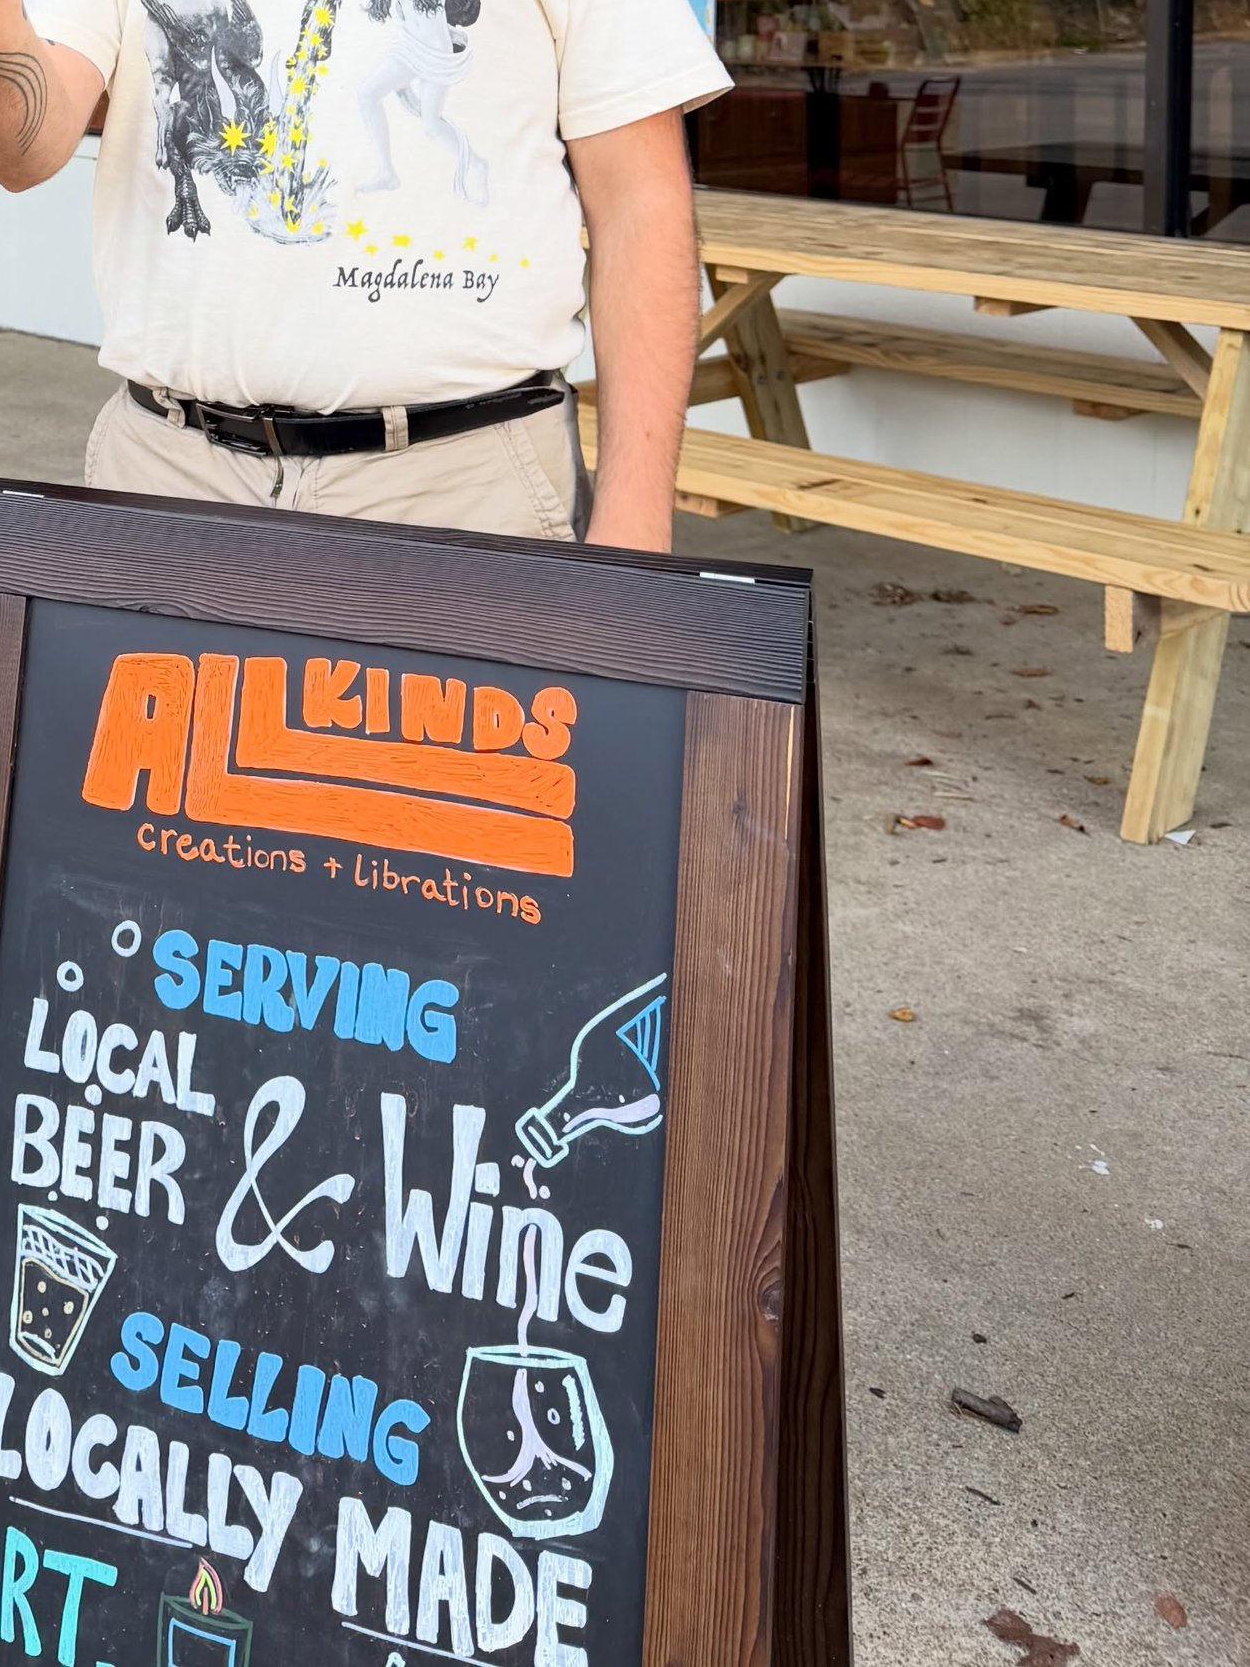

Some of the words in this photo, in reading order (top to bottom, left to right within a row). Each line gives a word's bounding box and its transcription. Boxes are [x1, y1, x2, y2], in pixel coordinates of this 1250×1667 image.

[333, 259, 454, 303] Magdalena
[462, 270, 500, 303] Bay
[303, 657, 578, 761] KINDS
[136, 822, 307, 874] creations
[354, 853, 543, 926] librations
[23, 997, 216, 1117] LOCAL
[153, 929, 460, 1064] SERVING
[10, 1092, 187, 1225] BEER
[216, 1075, 355, 1274] &
[380, 1092, 634, 1334] Wine
[110, 1312, 432, 1487] SELLING
[330, 1495, 593, 1667] MADE
